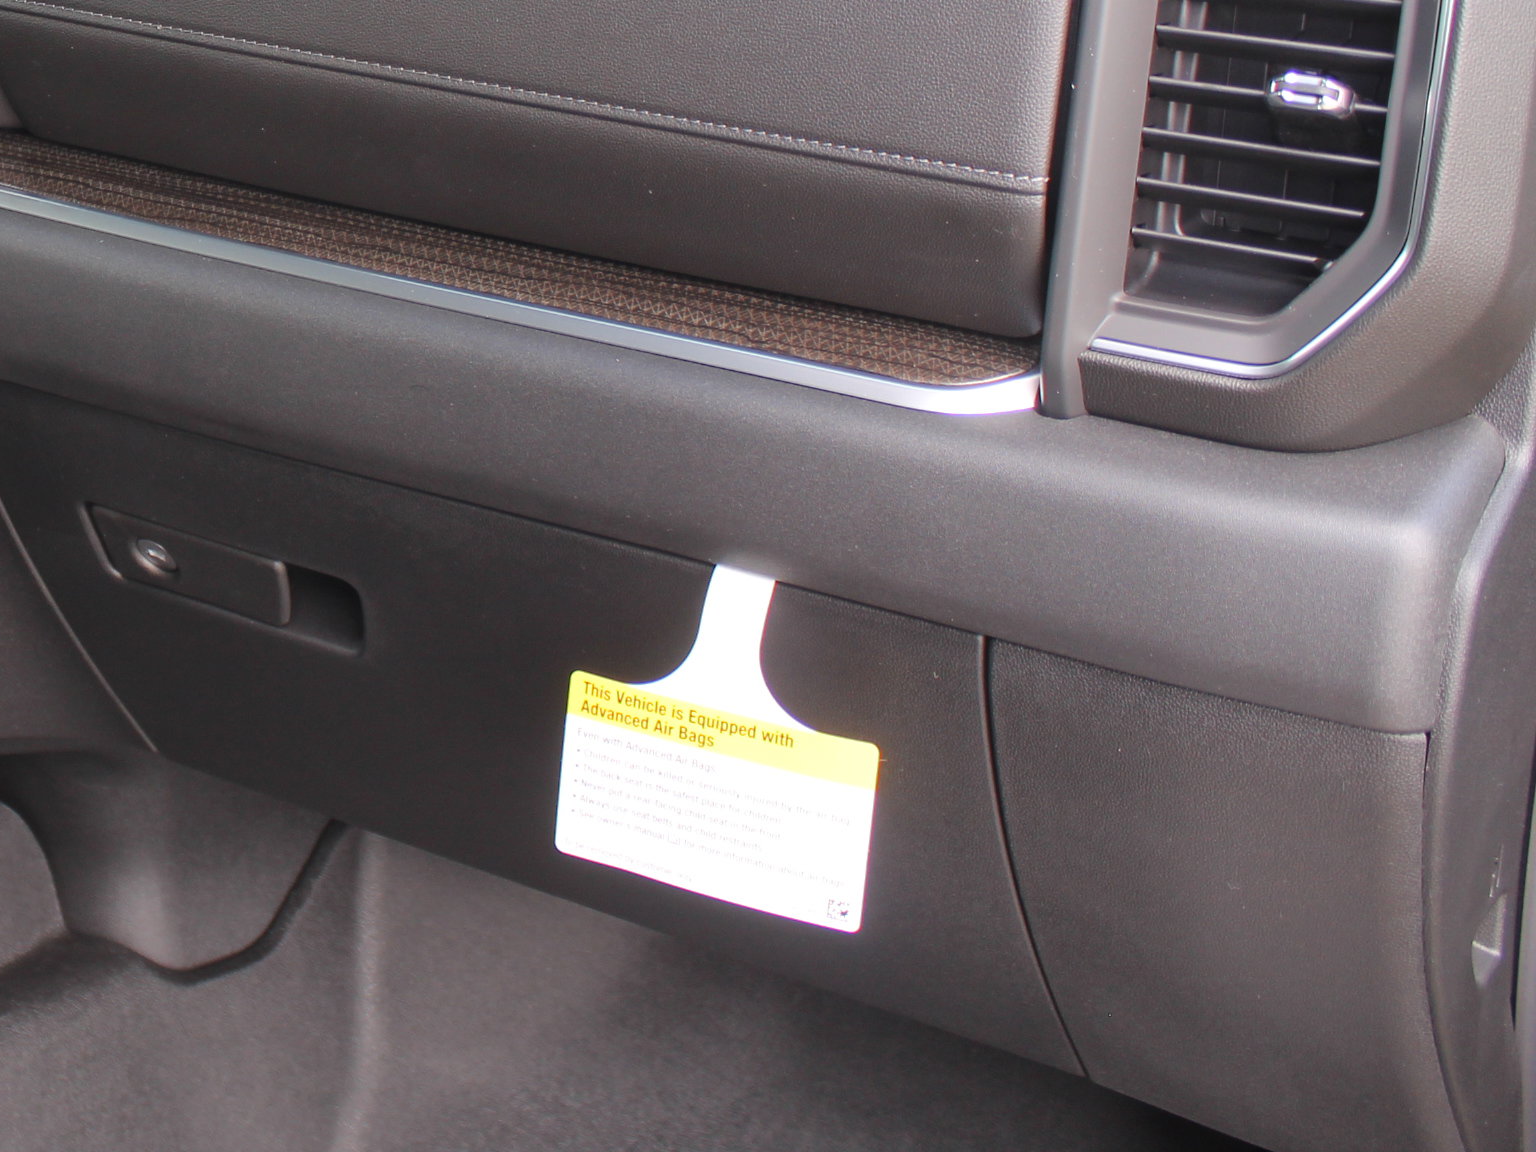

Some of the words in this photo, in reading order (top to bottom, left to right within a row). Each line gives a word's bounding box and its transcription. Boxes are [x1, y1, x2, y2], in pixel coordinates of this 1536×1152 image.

[580, 699, 649, 730] Advanced
[653, 720, 674, 736] Air
[678, 726, 715, 748] Bags
[582, 681, 611, 701] This
[616, 690, 667, 716] Vehicle
[671, 705, 684, 721] is
[688, 709, 757, 739] Equipped
[761, 729, 795, 749] with
[577, 727, 600, 741] Even
[602, 734, 623, 747] with
[626, 740, 673, 761] Advanced
[674, 753, 689, 765] Air
[691, 758, 717, 774] Bags
